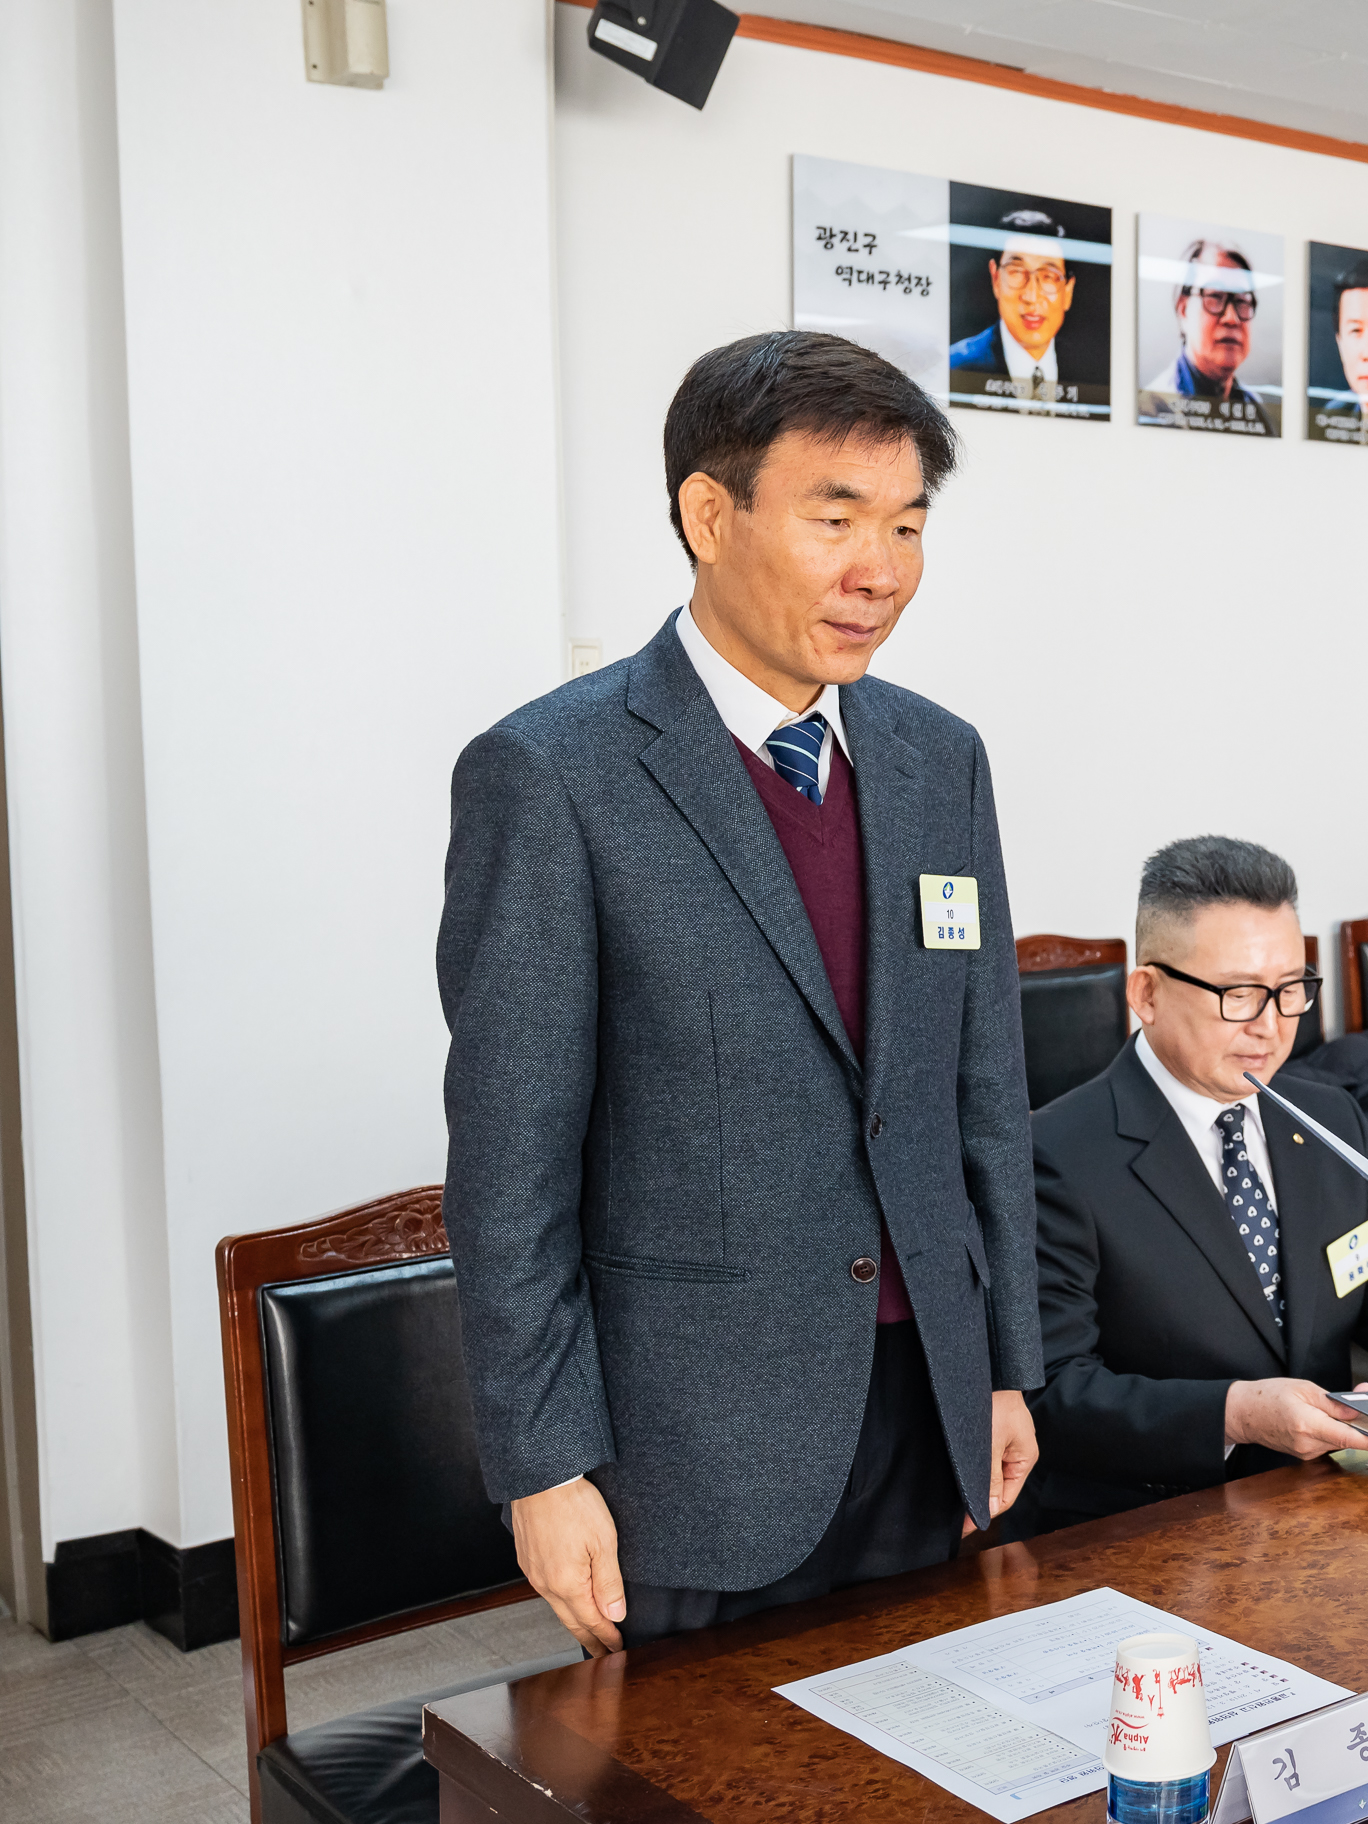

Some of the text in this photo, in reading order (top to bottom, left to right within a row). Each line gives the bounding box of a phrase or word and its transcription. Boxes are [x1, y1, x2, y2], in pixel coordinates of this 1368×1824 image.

[815, 225, 879, 256] 광진구
[834, 265, 933, 298] 역대구청장
[946, 909, 954, 919] 10
[1123, 1732, 1149, 1745] Alpha
[1272, 1747, 1301, 1792] 김
